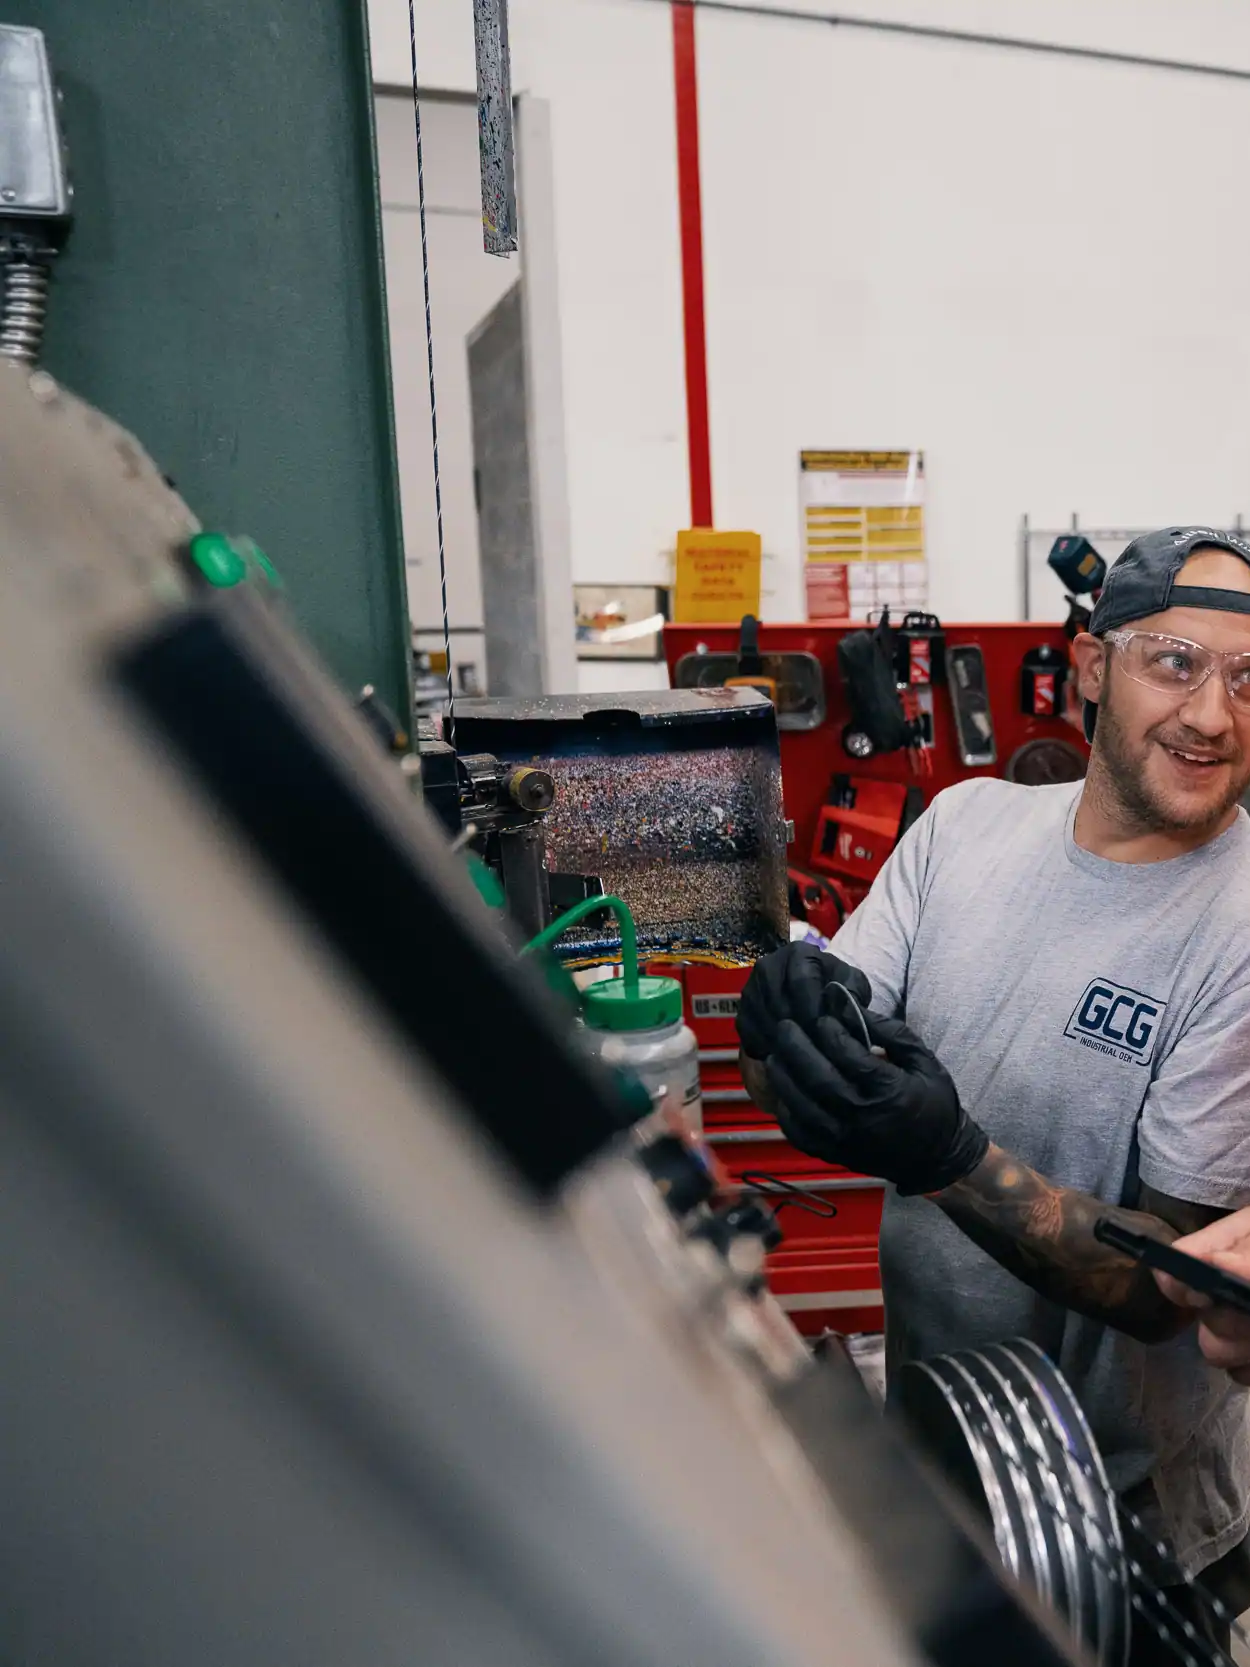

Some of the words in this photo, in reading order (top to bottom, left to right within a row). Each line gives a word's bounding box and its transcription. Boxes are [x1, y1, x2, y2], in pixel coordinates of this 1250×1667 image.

[1077, 985, 1159, 1050] GCG
[1079, 1036, 1117, 1058] INDUSTRIAL
[1118, 1051, 1133, 1063] OEM
